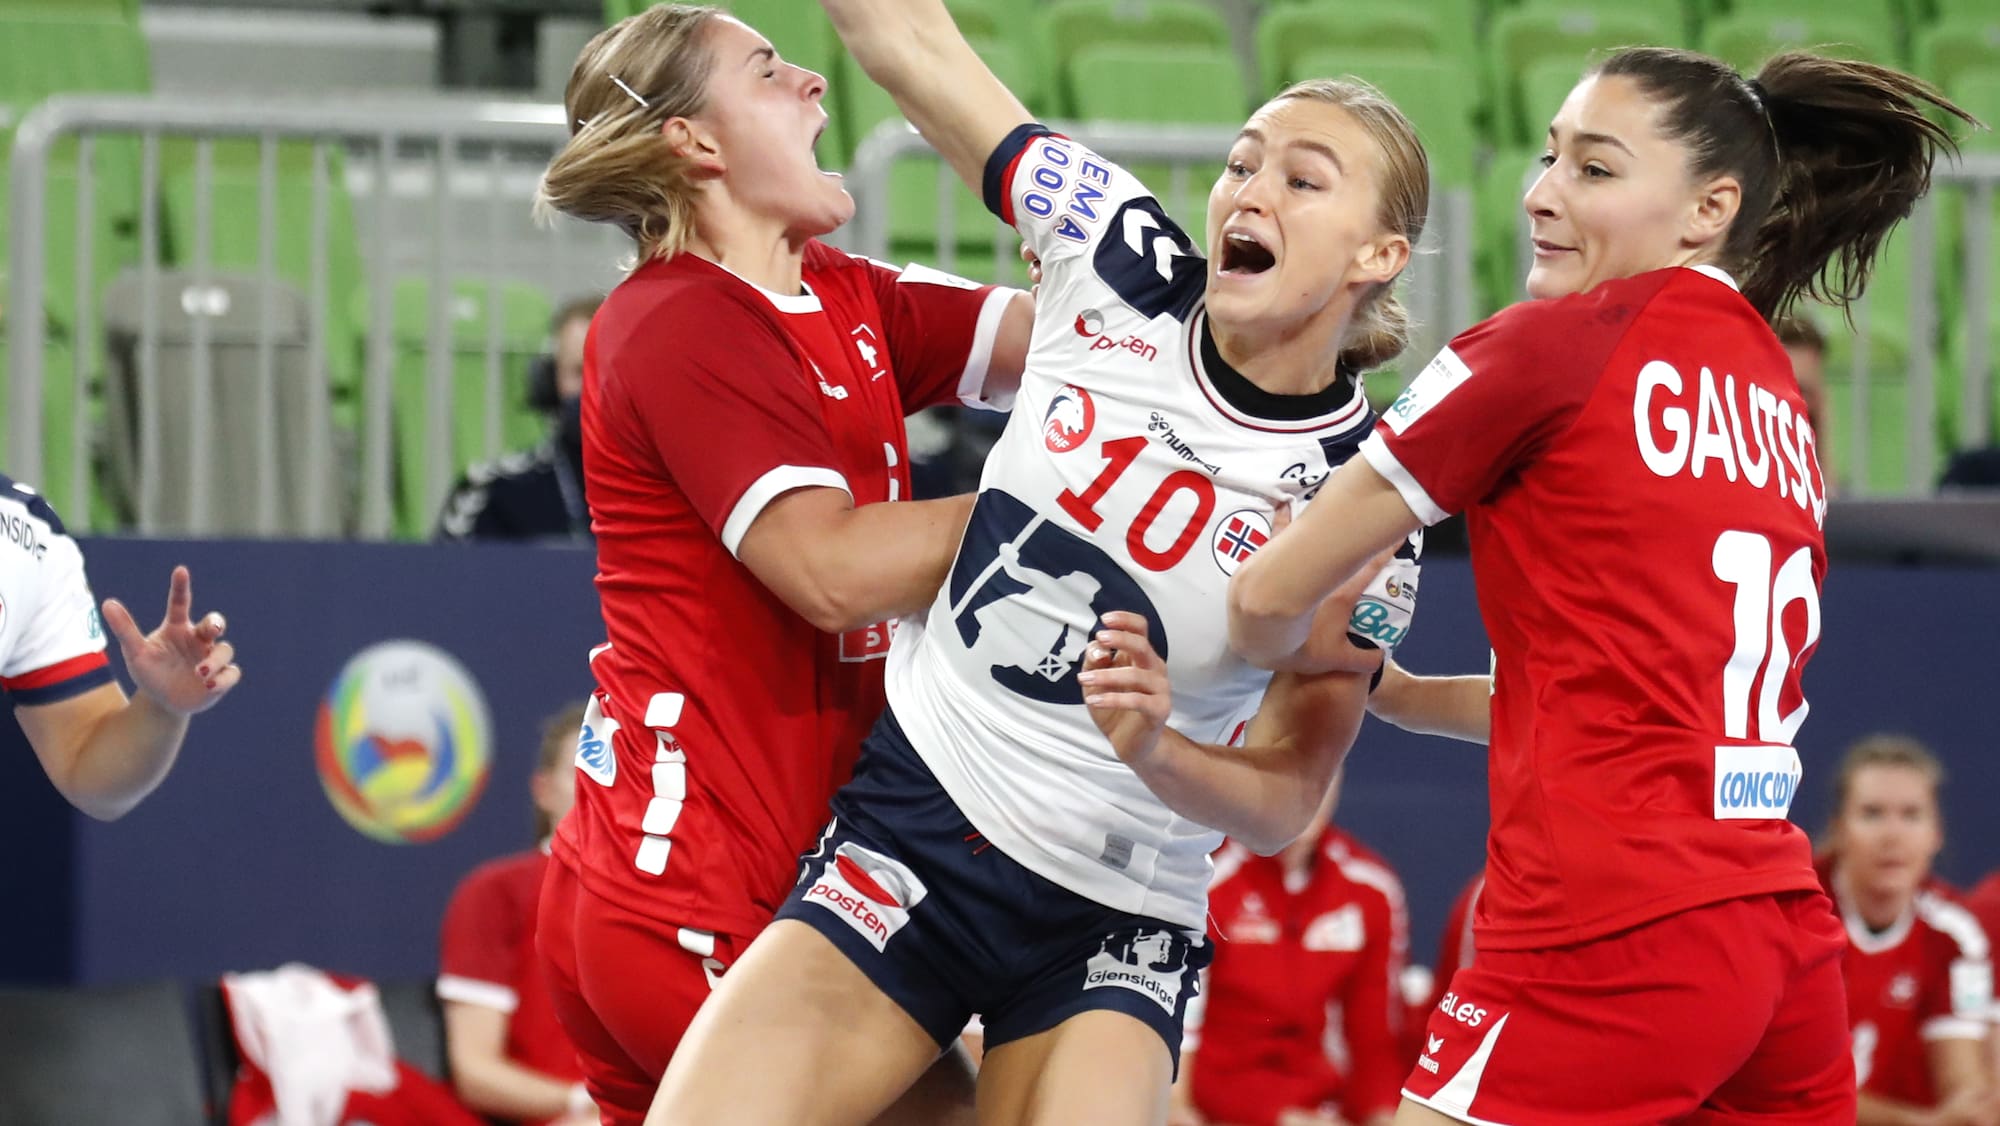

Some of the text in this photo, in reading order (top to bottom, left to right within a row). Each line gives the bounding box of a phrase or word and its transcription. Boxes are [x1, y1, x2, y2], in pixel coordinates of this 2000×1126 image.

[1023, 138, 1073, 217] 000
[1055, 152, 1112, 241] EMA
[1046, 427, 1070, 449] NHF
[1633, 360, 1828, 532] GAUTSC
[1055, 435, 1216, 573] 10
[1711, 529, 1822, 746] 10
[808, 884, 888, 942] posten
[1088, 970, 1174, 1008] Gjensidige
